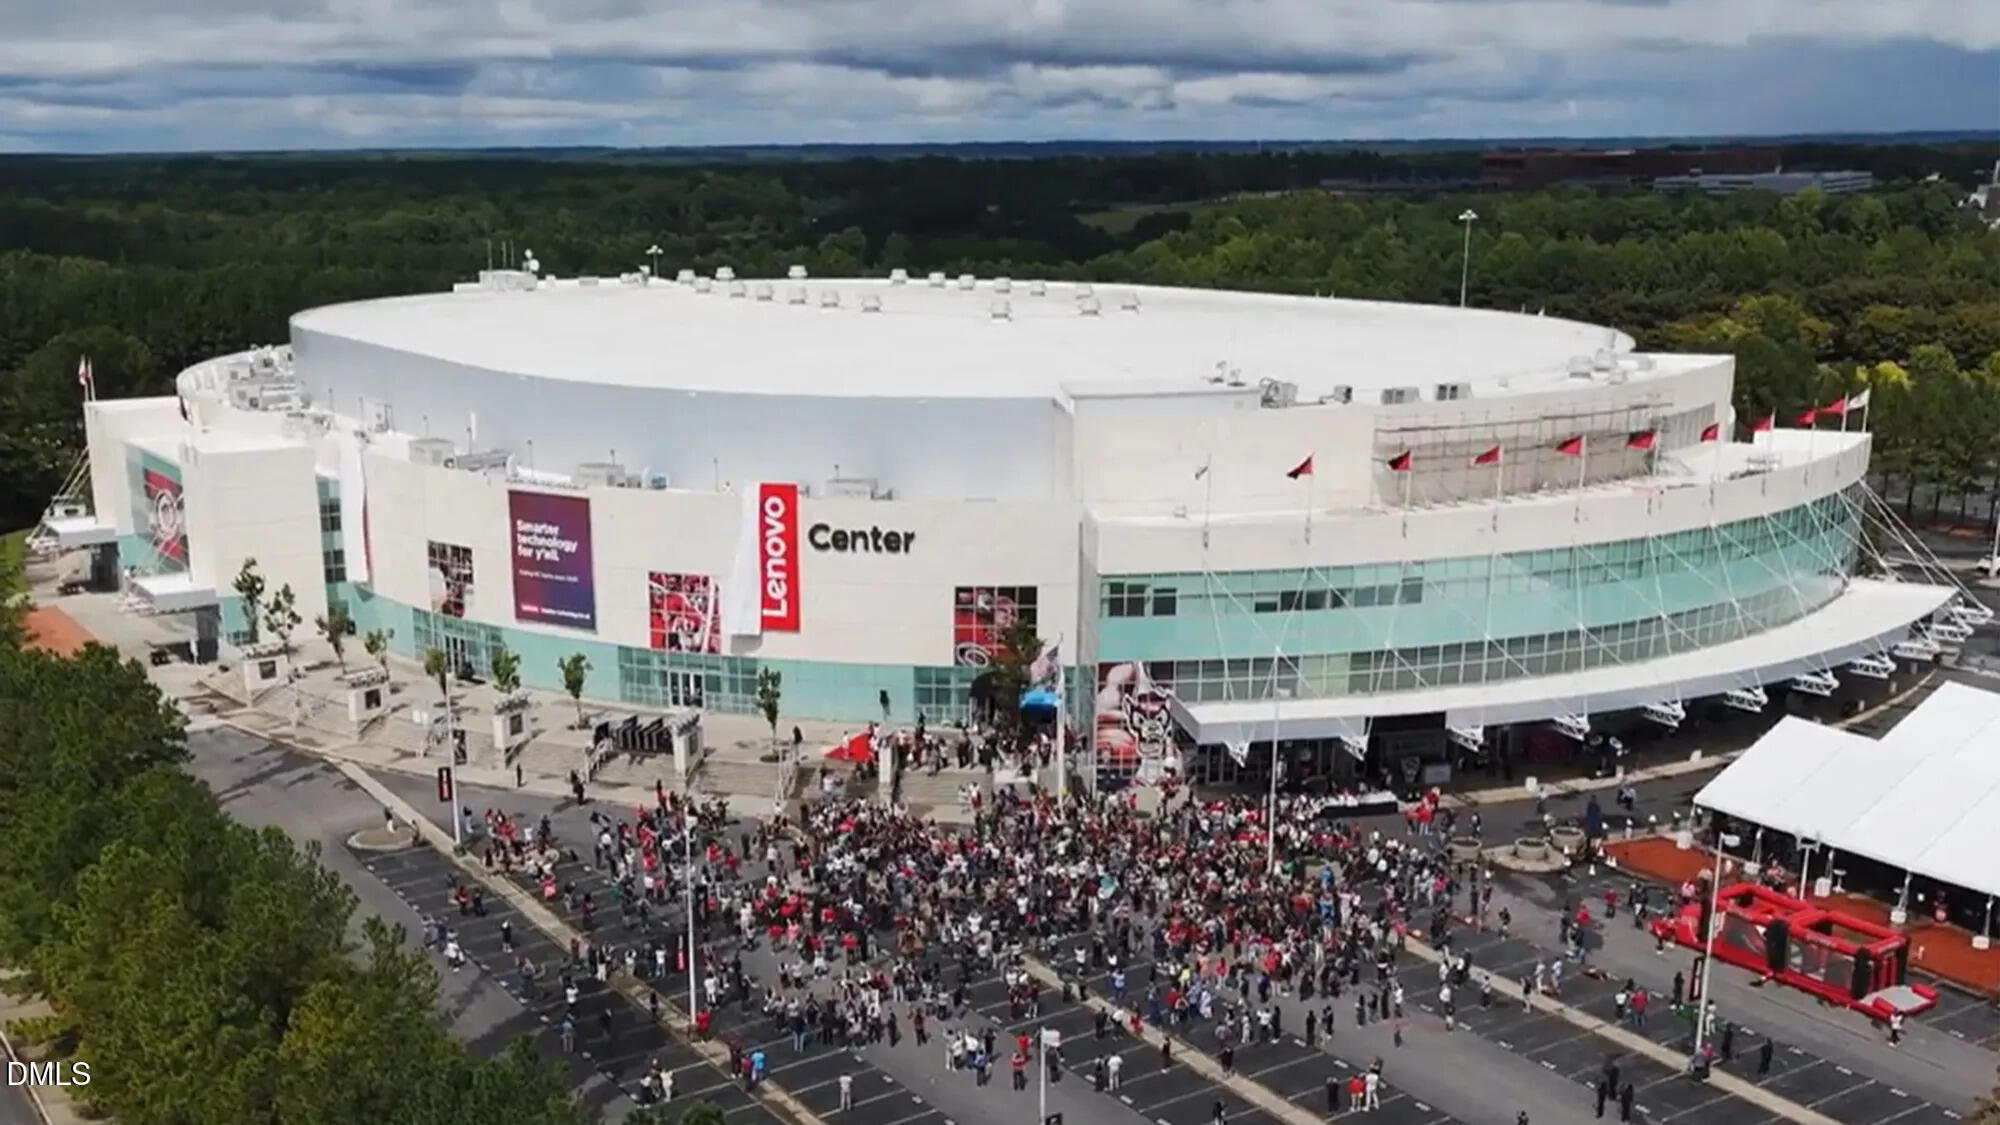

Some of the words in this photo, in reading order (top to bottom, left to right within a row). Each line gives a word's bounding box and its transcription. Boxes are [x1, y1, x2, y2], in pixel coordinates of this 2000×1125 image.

[516, 519, 559, 535] Smarter
[516, 532, 579, 553] technology
[808, 523, 916, 554] Center
[517, 544, 533, 557] for
[762, 496, 789, 619] Lenovo
